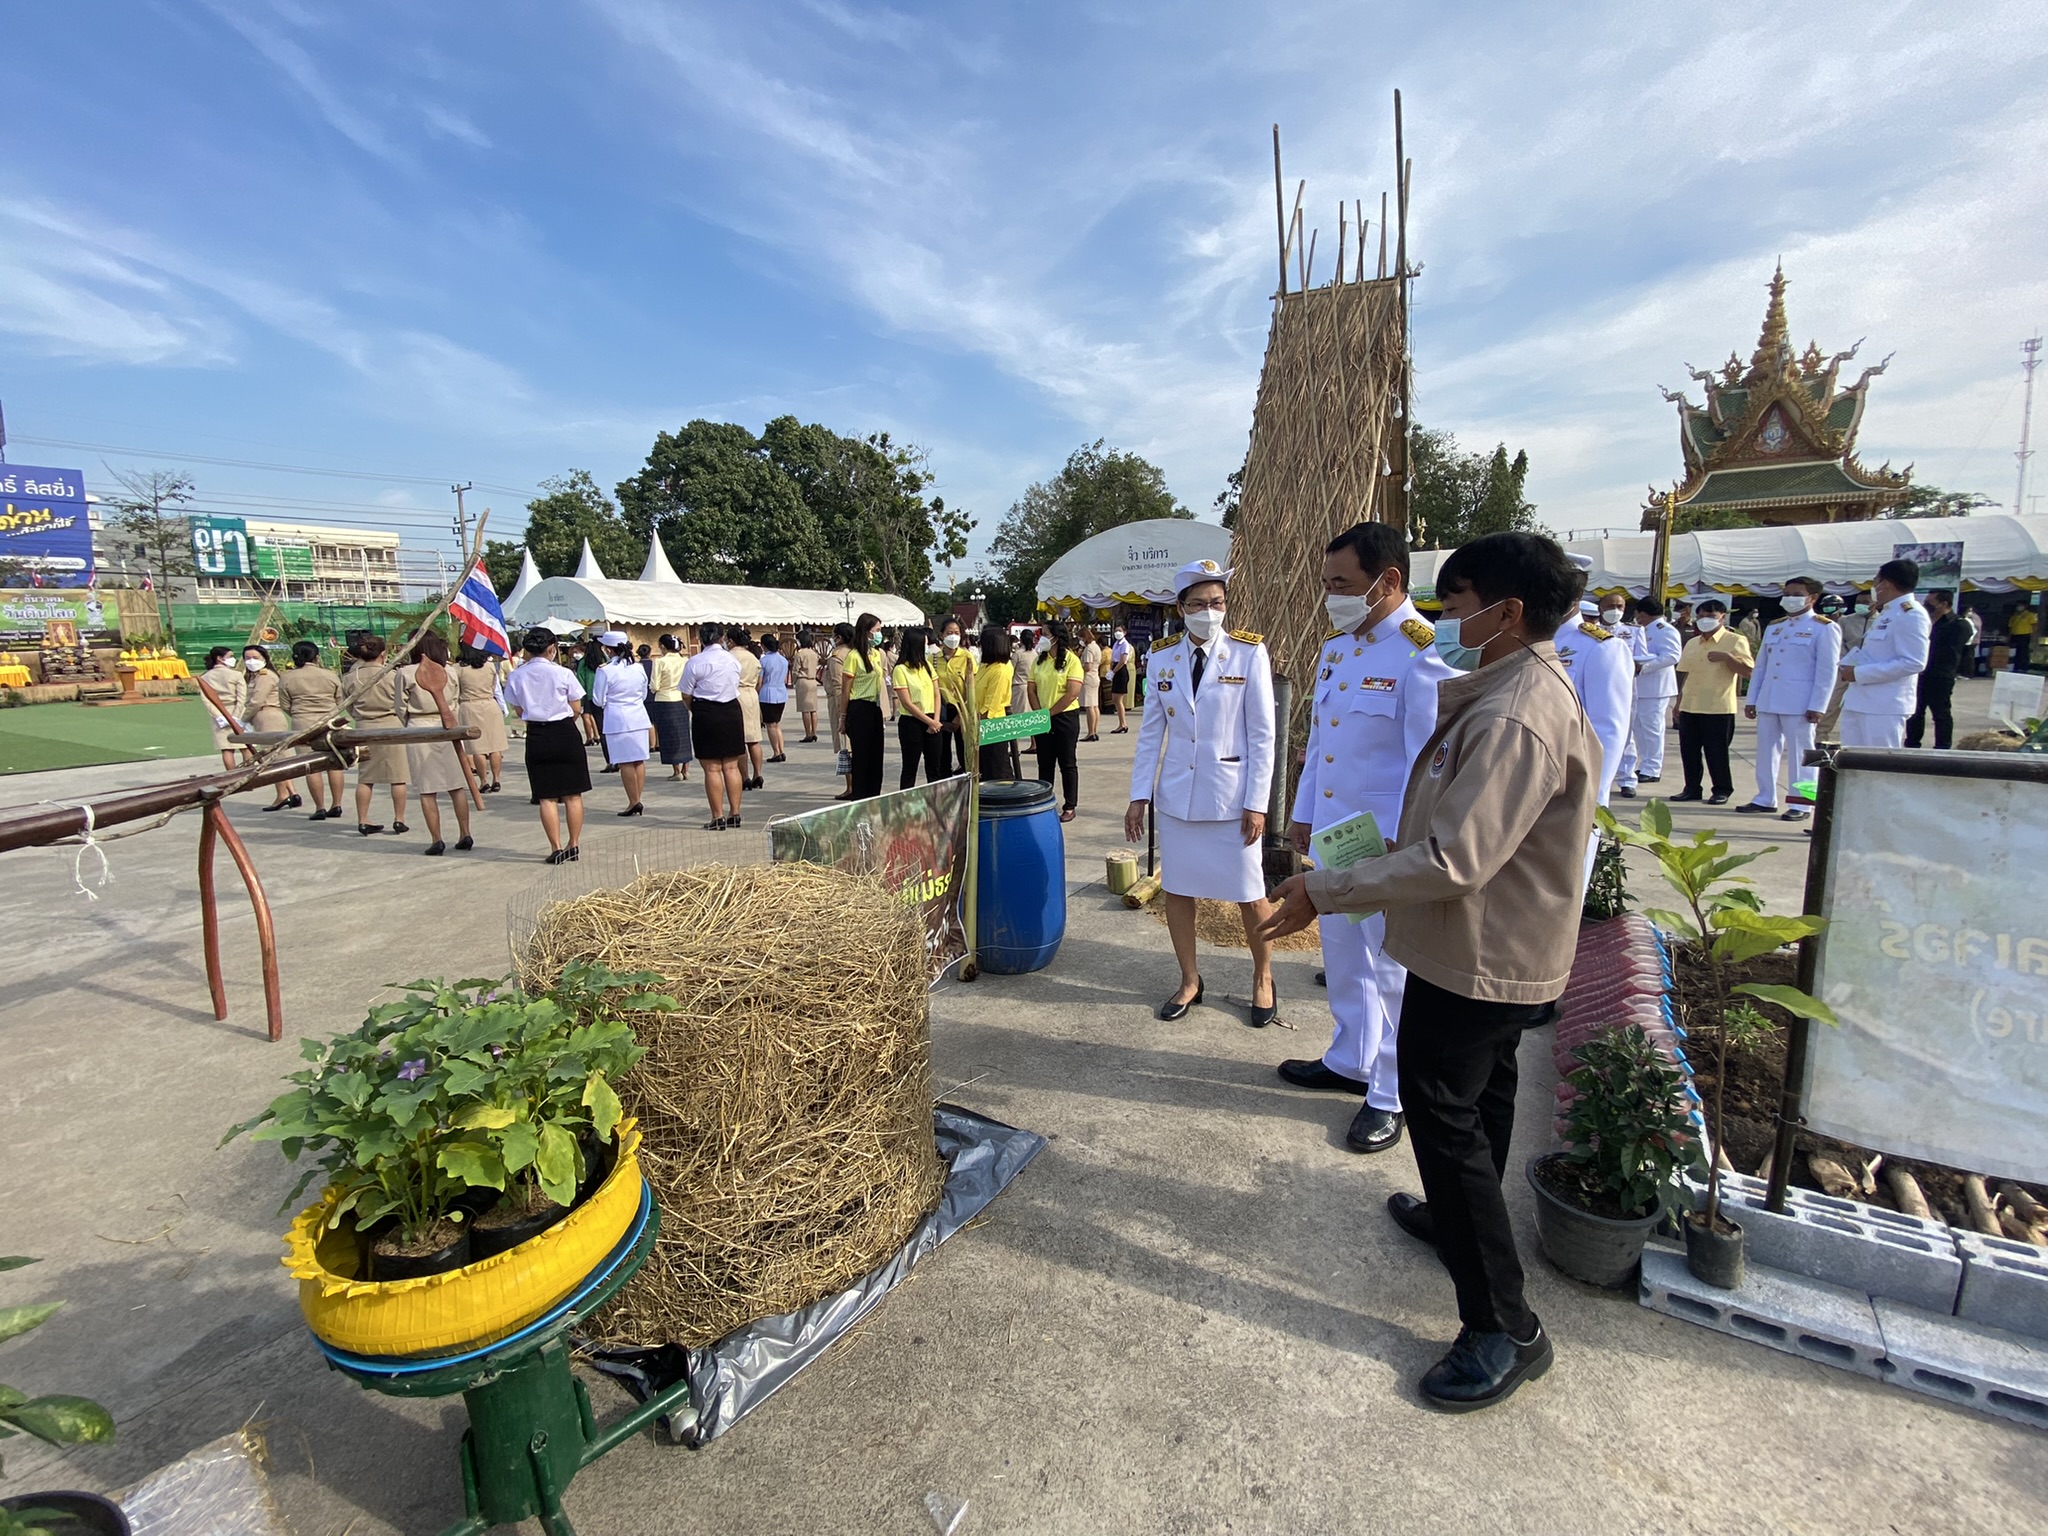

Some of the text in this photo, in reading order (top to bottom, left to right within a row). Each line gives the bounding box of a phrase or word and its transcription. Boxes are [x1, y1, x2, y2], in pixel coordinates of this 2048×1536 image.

[194, 528, 250, 574] ยา
[1142, 546, 1169, 560] บริการ
[3, 603, 77, 619] วันดินโลก
